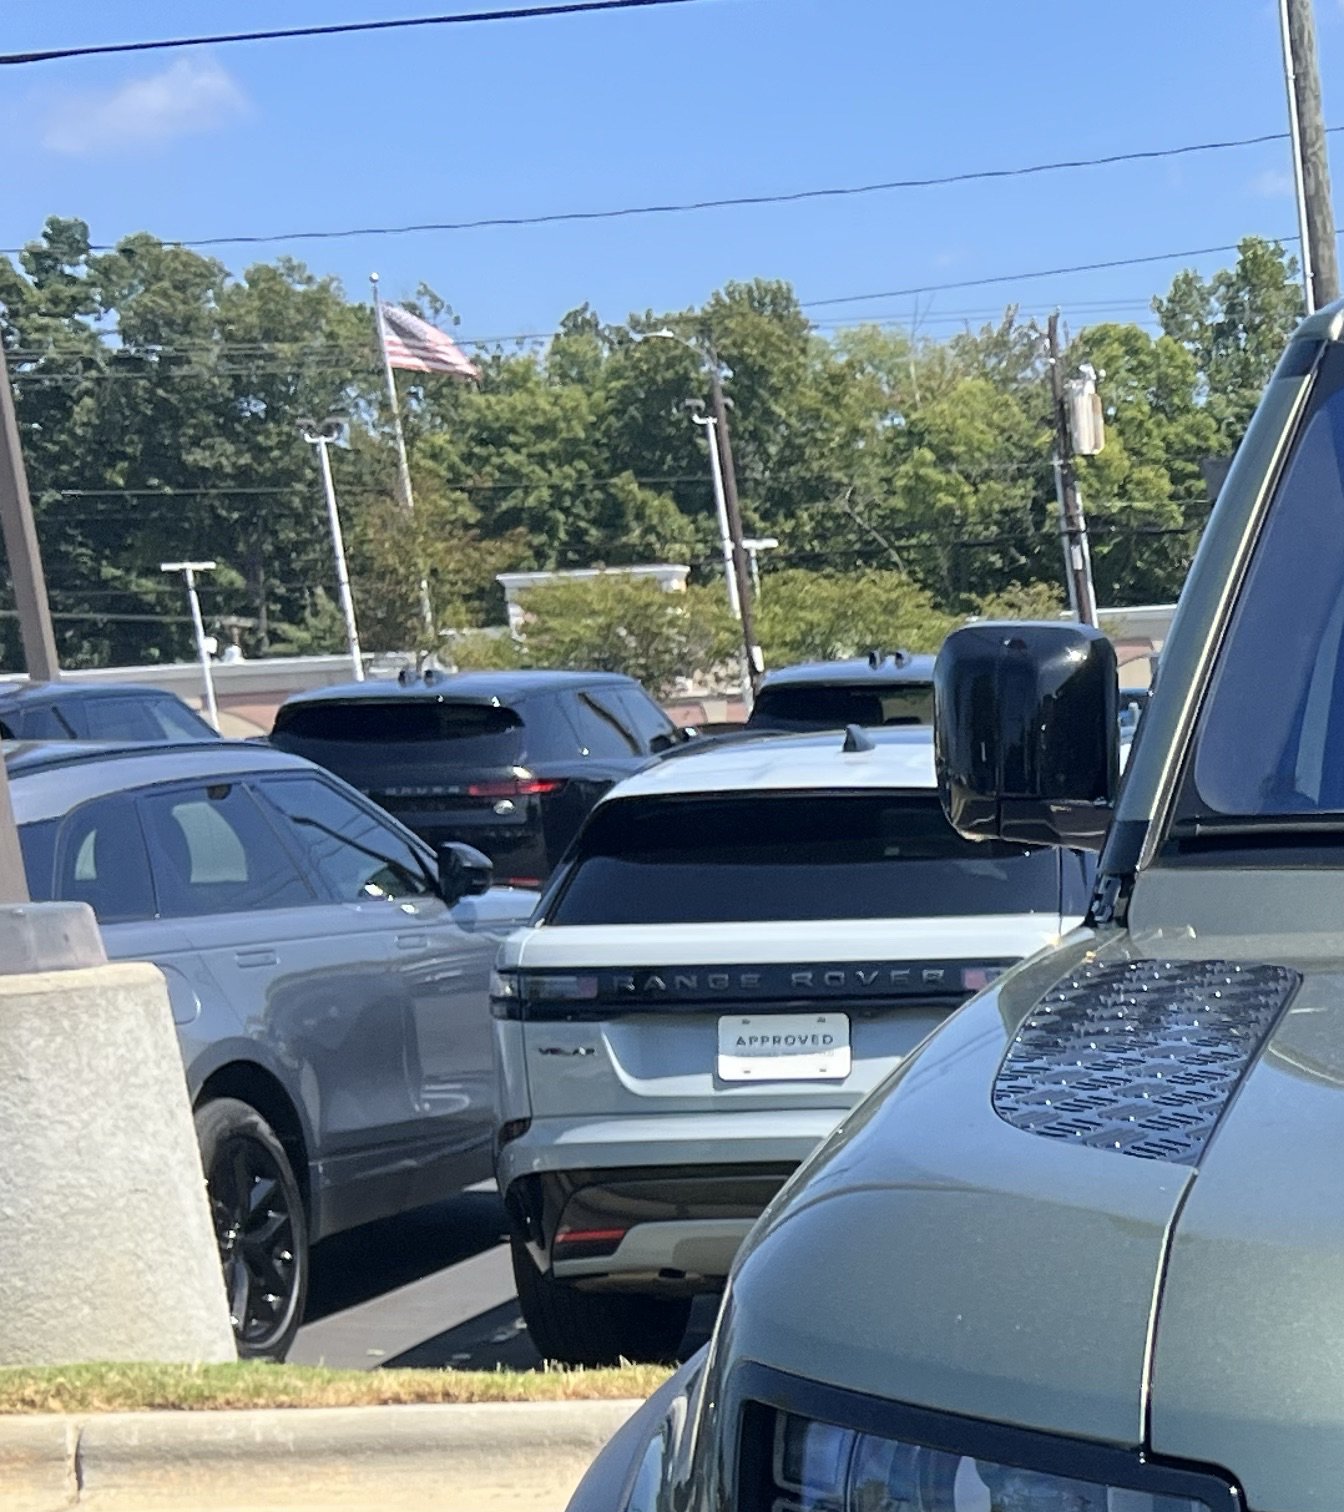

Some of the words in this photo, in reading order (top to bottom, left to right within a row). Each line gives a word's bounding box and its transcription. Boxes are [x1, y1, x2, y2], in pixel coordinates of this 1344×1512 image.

[612, 973, 762, 991] RANGE
[790, 968, 946, 988] ROVER
[735, 1033, 835, 1047] APPROVED
